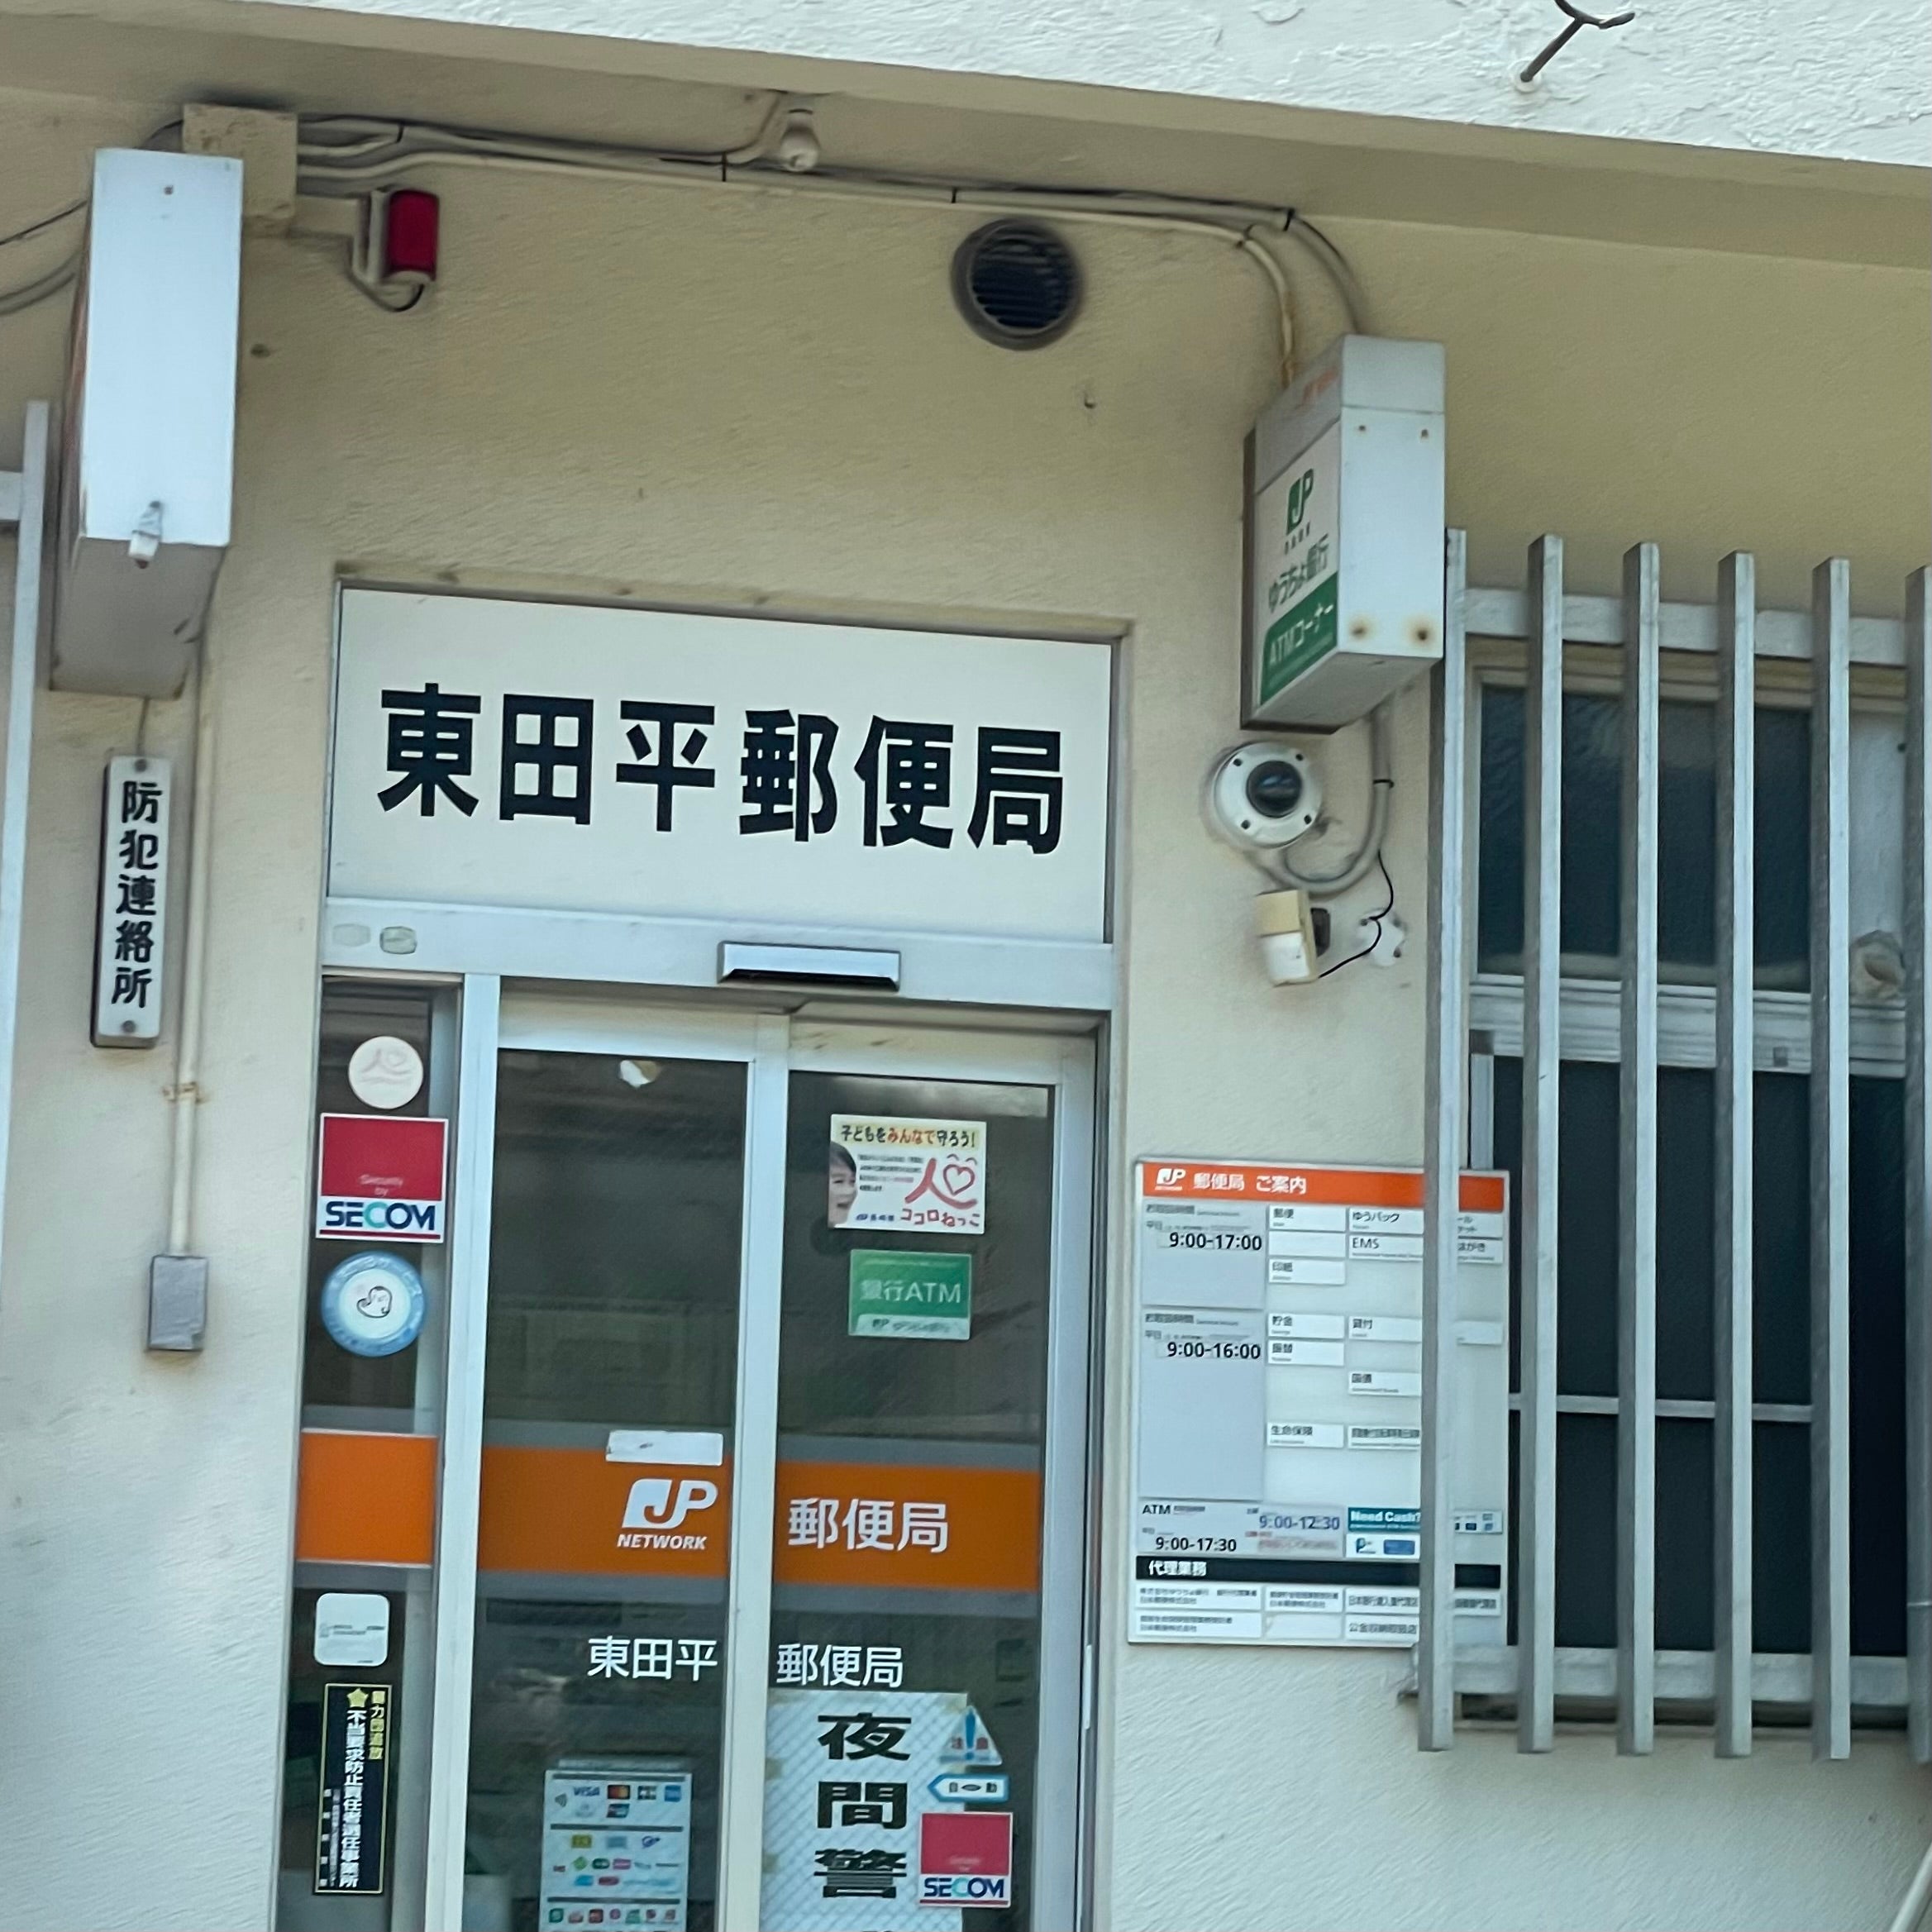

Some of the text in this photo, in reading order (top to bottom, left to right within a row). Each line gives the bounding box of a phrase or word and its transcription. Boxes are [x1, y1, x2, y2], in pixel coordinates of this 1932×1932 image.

[1286, 468, 1314, 536] JP
[377, 683, 1064, 855] 東田平郵便局
[111, 780, 163, 1009] 防犯連絡所
[1194, 1172, 1245, 1191] 郵便局
[1256, 1176, 1307, 1195] ご案内
[326, 1201, 436, 1231] SECOM
[900, 1208, 980, 1228] ココロねっこ
[1169, 1232, 1262, 1251] 9:00-17:00
[1352, 1238, 1379, 1248] EMS
[1166, 1341, 1262, 1360] 9:00-16:00
[622, 1478, 718, 1529] JP
[1143, 1505, 1171, 1515] ATM
[788, 1498, 948, 1553] 郵便局
[1259, 1515, 1340, 1530] 9:00-12:30
[617, 1534, 708, 1551] NETWORK
[1155, 1536, 1237, 1552] 9:00-17:30
[587, 1636, 903, 1688] 東田平 郵便局
[813, 1712, 912, 1932] 夜間警
[924, 1877, 1004, 1899] SECOM
